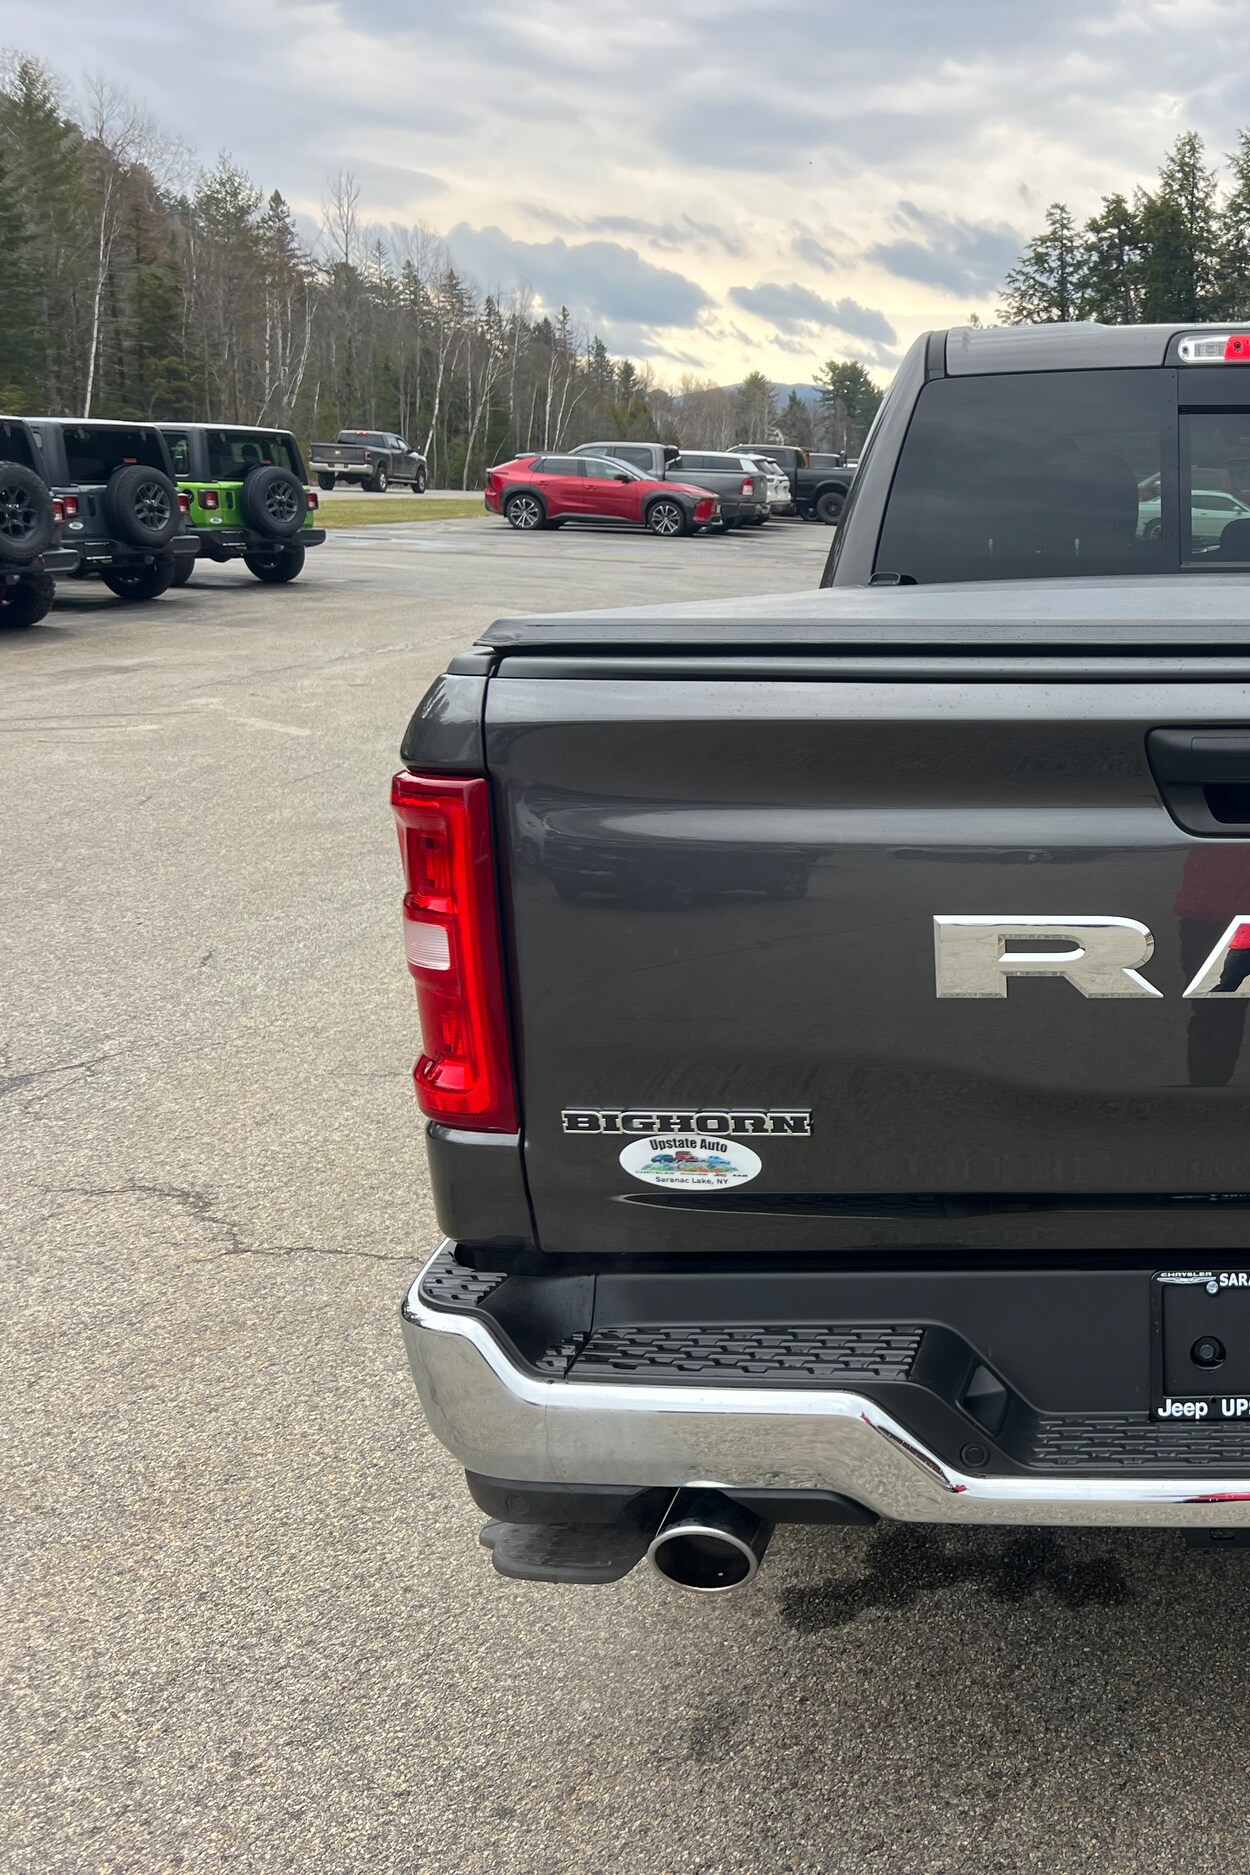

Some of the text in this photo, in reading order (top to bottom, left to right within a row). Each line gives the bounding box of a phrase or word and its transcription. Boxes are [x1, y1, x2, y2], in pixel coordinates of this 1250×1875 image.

[561, 1107, 813, 1136] BIGHORN
[649, 1138, 728, 1153] Upstate Auto
[655, 1176, 689, 1184] Saranac
[691, 1177, 714, 1185] Lake,
[1157, 1398, 1209, 1419] Jeep
